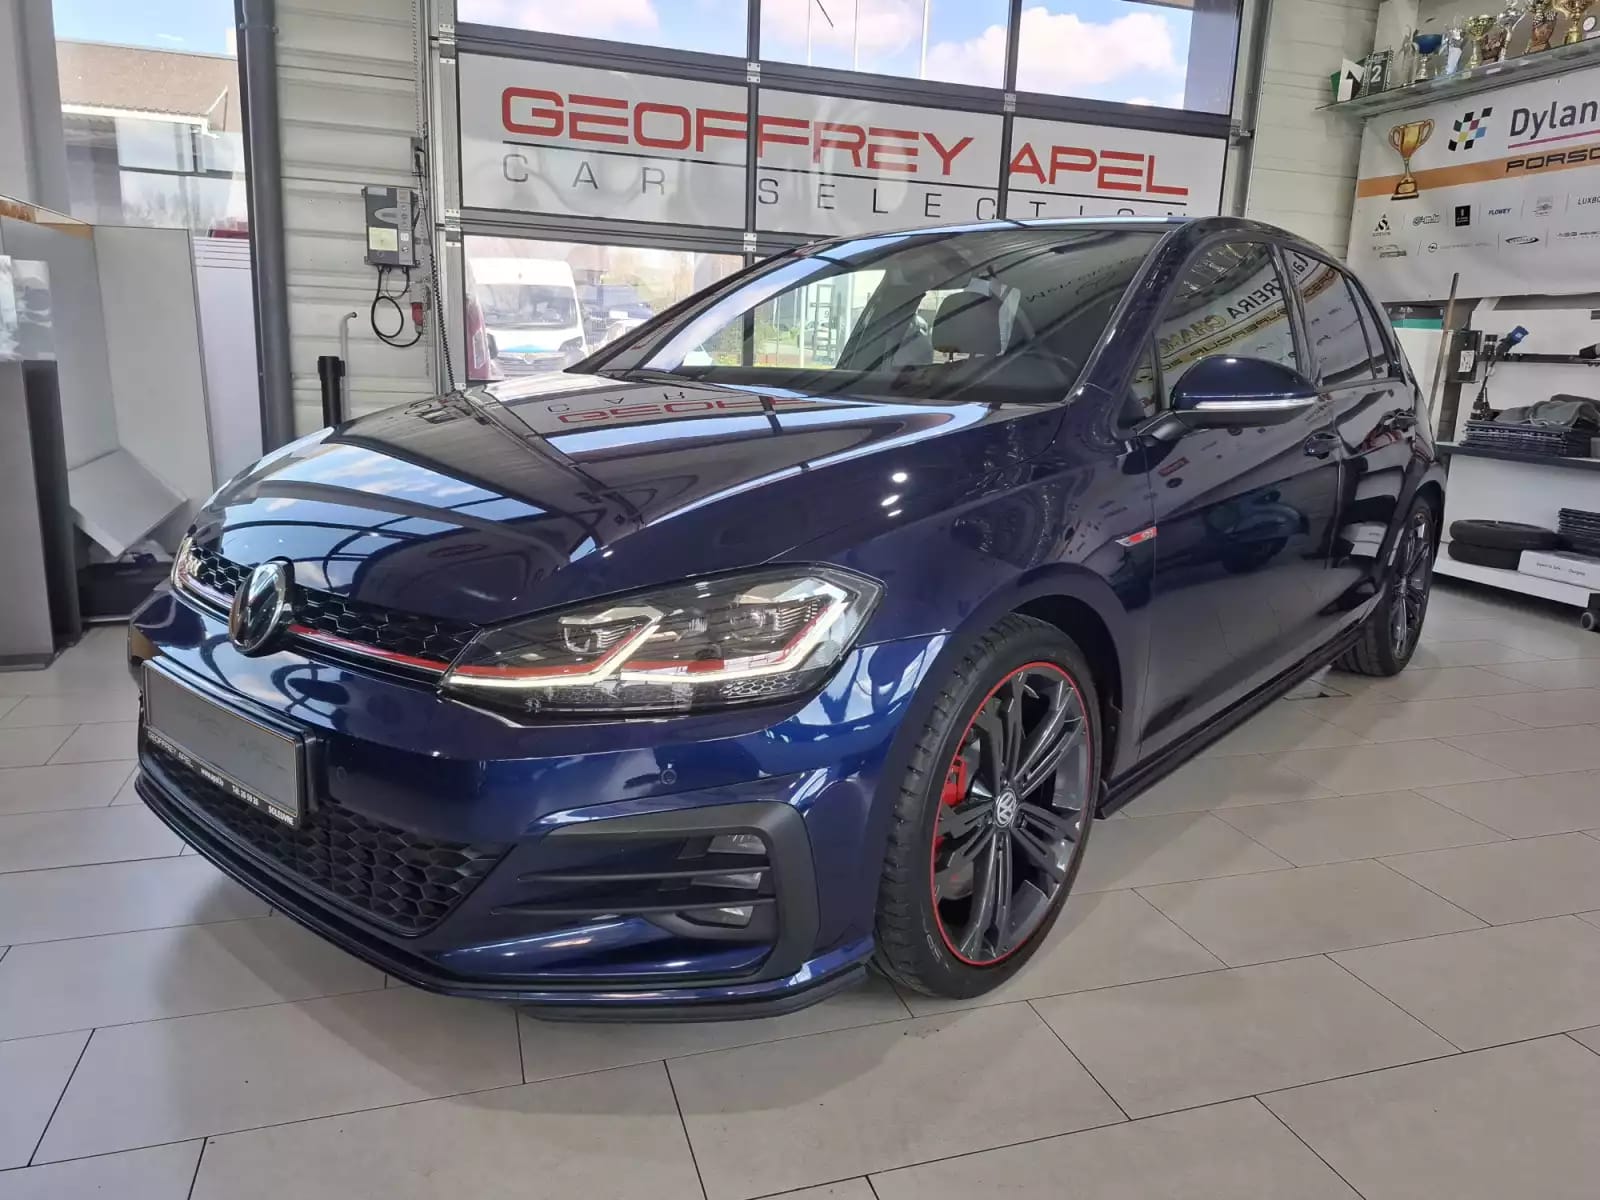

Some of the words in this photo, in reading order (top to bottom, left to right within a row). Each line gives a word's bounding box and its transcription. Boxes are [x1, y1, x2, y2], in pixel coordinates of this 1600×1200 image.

[1370, 65, 1382, 83] 2
[1509, 101, 1599, 140] Dylan
[501, 86, 974, 176] GEOFFREY
[1009, 142, 1189, 196] APEL
[502, 154, 666, 195] CAR
